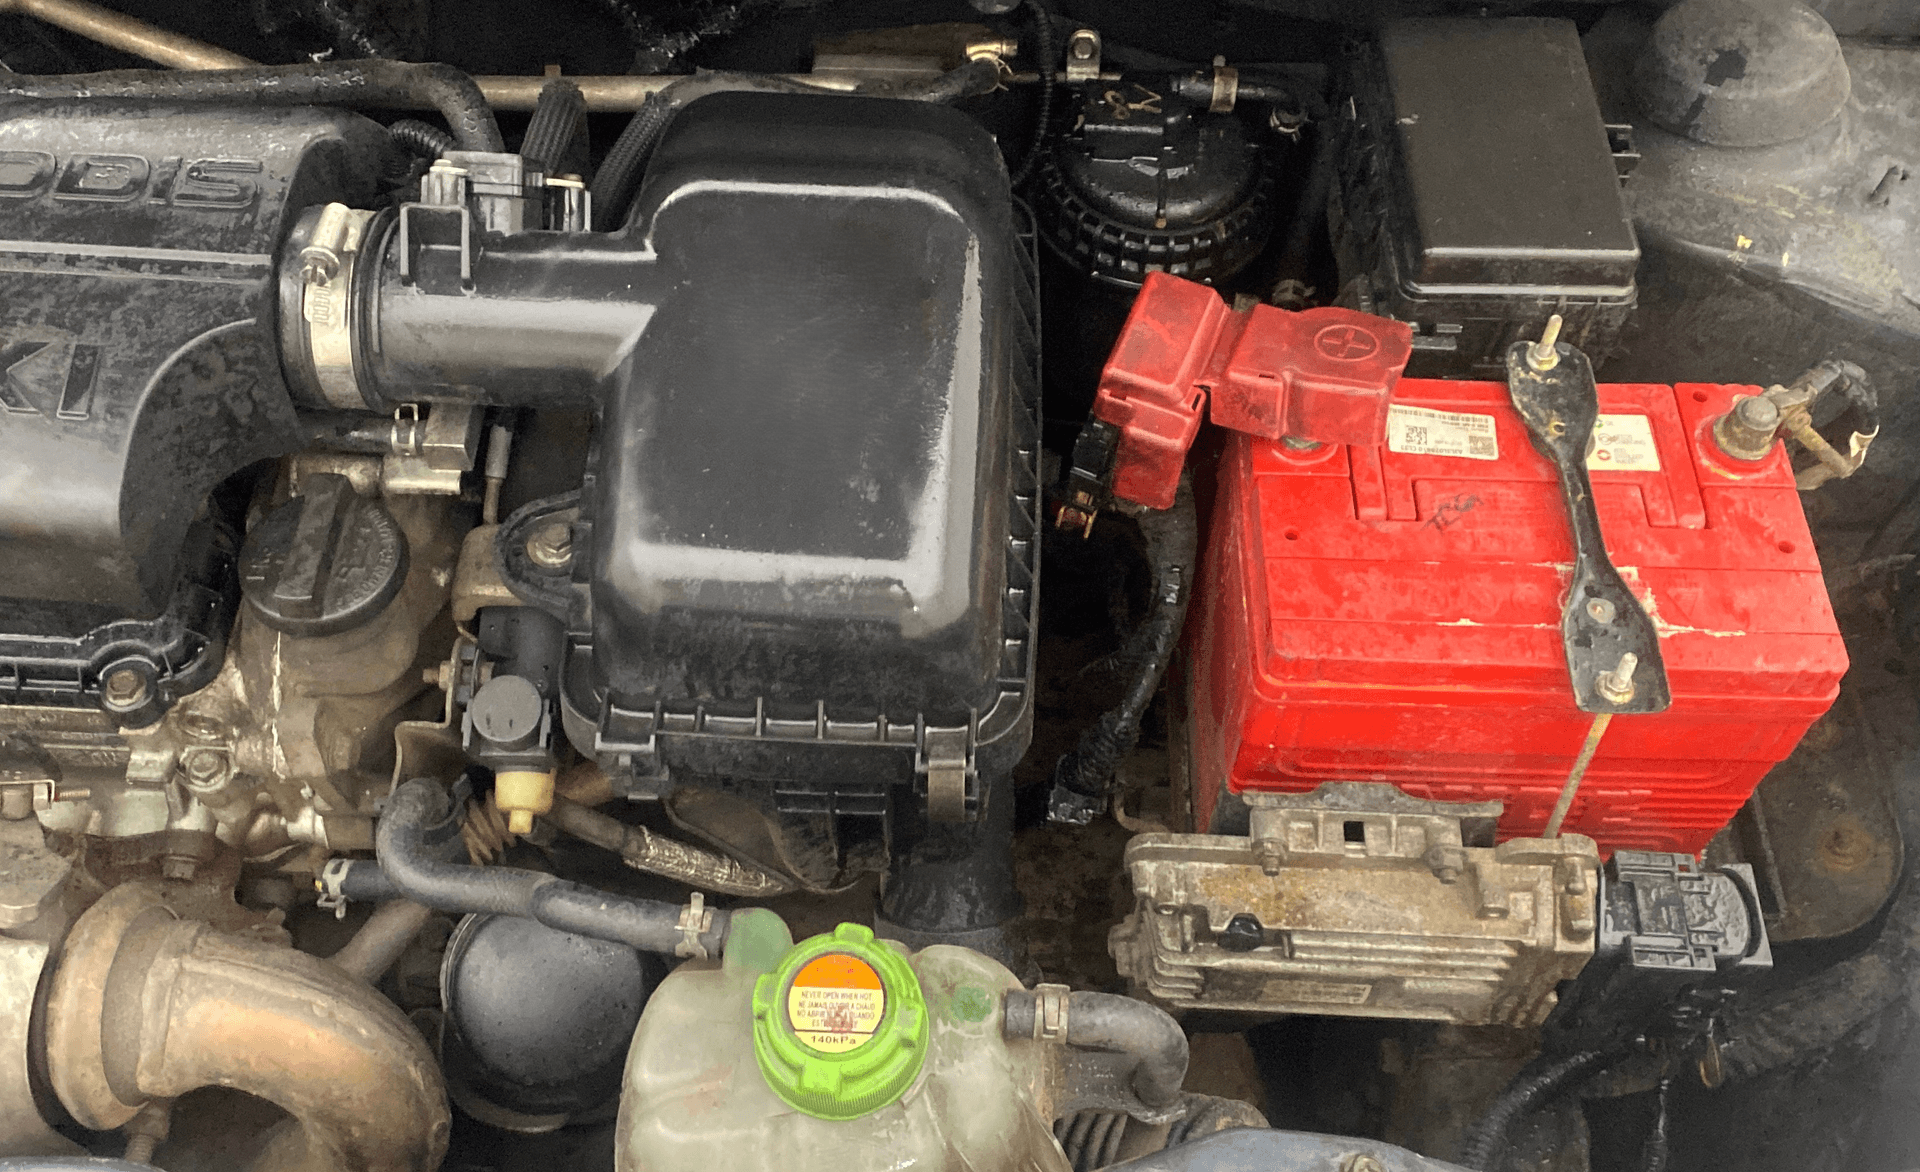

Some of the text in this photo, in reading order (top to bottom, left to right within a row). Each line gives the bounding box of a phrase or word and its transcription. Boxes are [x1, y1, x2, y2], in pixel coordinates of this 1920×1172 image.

[801, 990, 821, 999] NEVER
[823, 991, 839, 1000] OPEN
[811, 1035, 856, 1044] 140kPa
